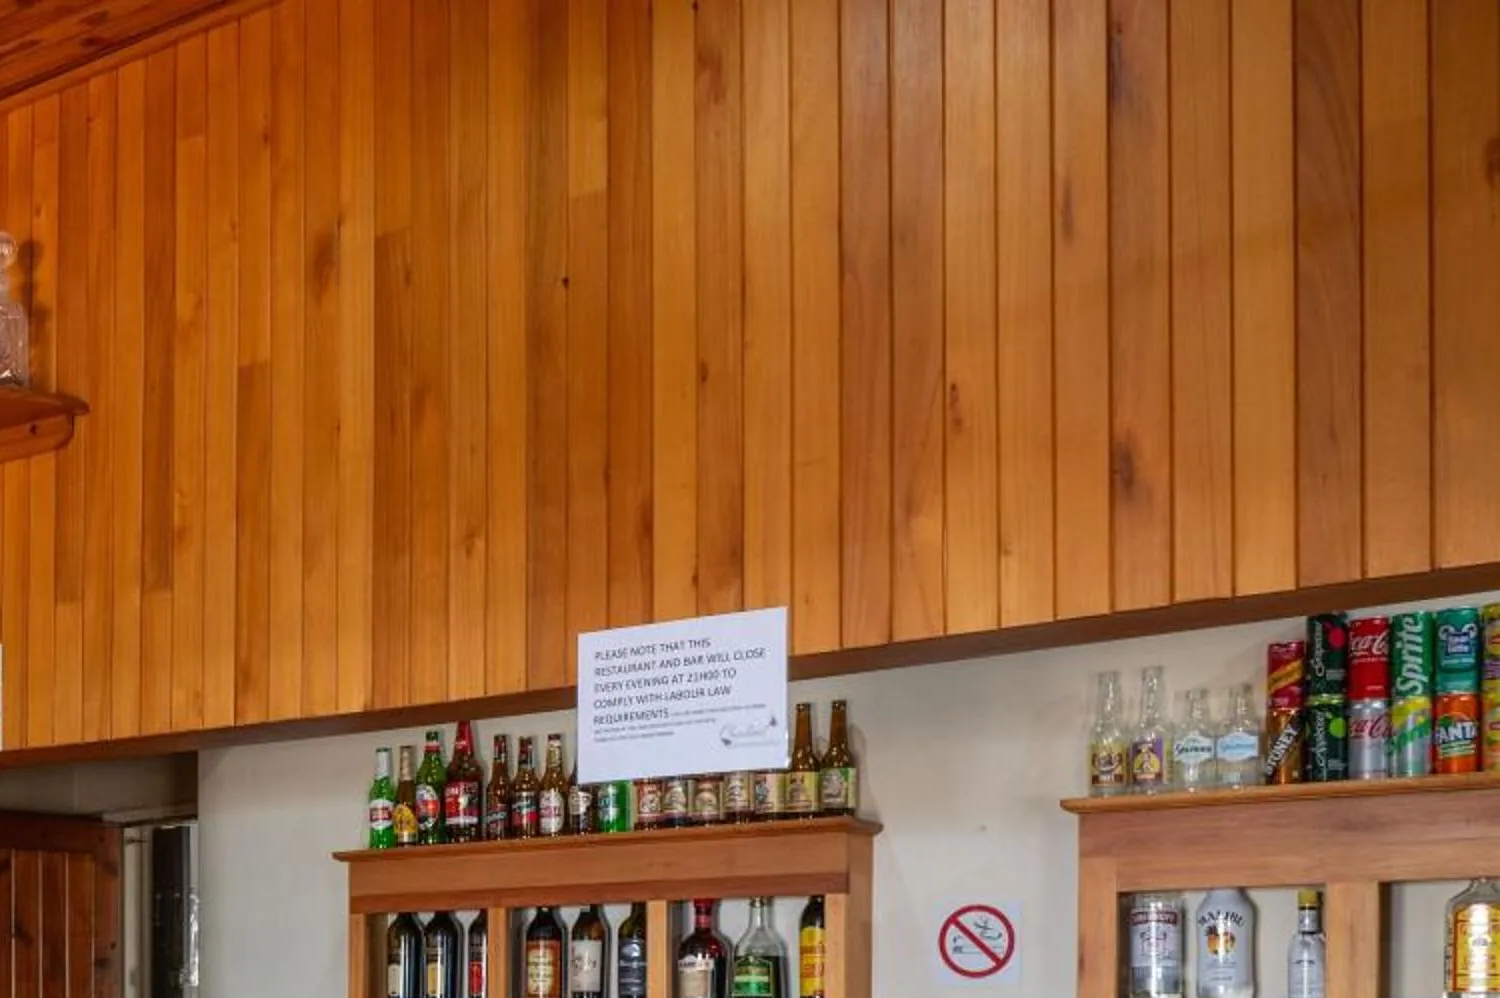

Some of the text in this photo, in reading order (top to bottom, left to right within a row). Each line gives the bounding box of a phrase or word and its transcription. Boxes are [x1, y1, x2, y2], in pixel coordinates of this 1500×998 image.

[595, 638, 711, 661] PLEASE NOTE THAT THIS
[595, 647, 767, 678] RESTAURANT AND BAR WILL CLOSE
[1395, 615, 1429, 695] Sprite
[594, 681, 624, 694] EVERY
[625, 676, 669, 691] EVENING
[671, 673, 685, 685] AT
[722, 667, 737, 679] TO
[593, 685, 732, 710] COMPLY WITH LABOUR LAW
[593, 708, 670, 726] REQUIREMENTS
